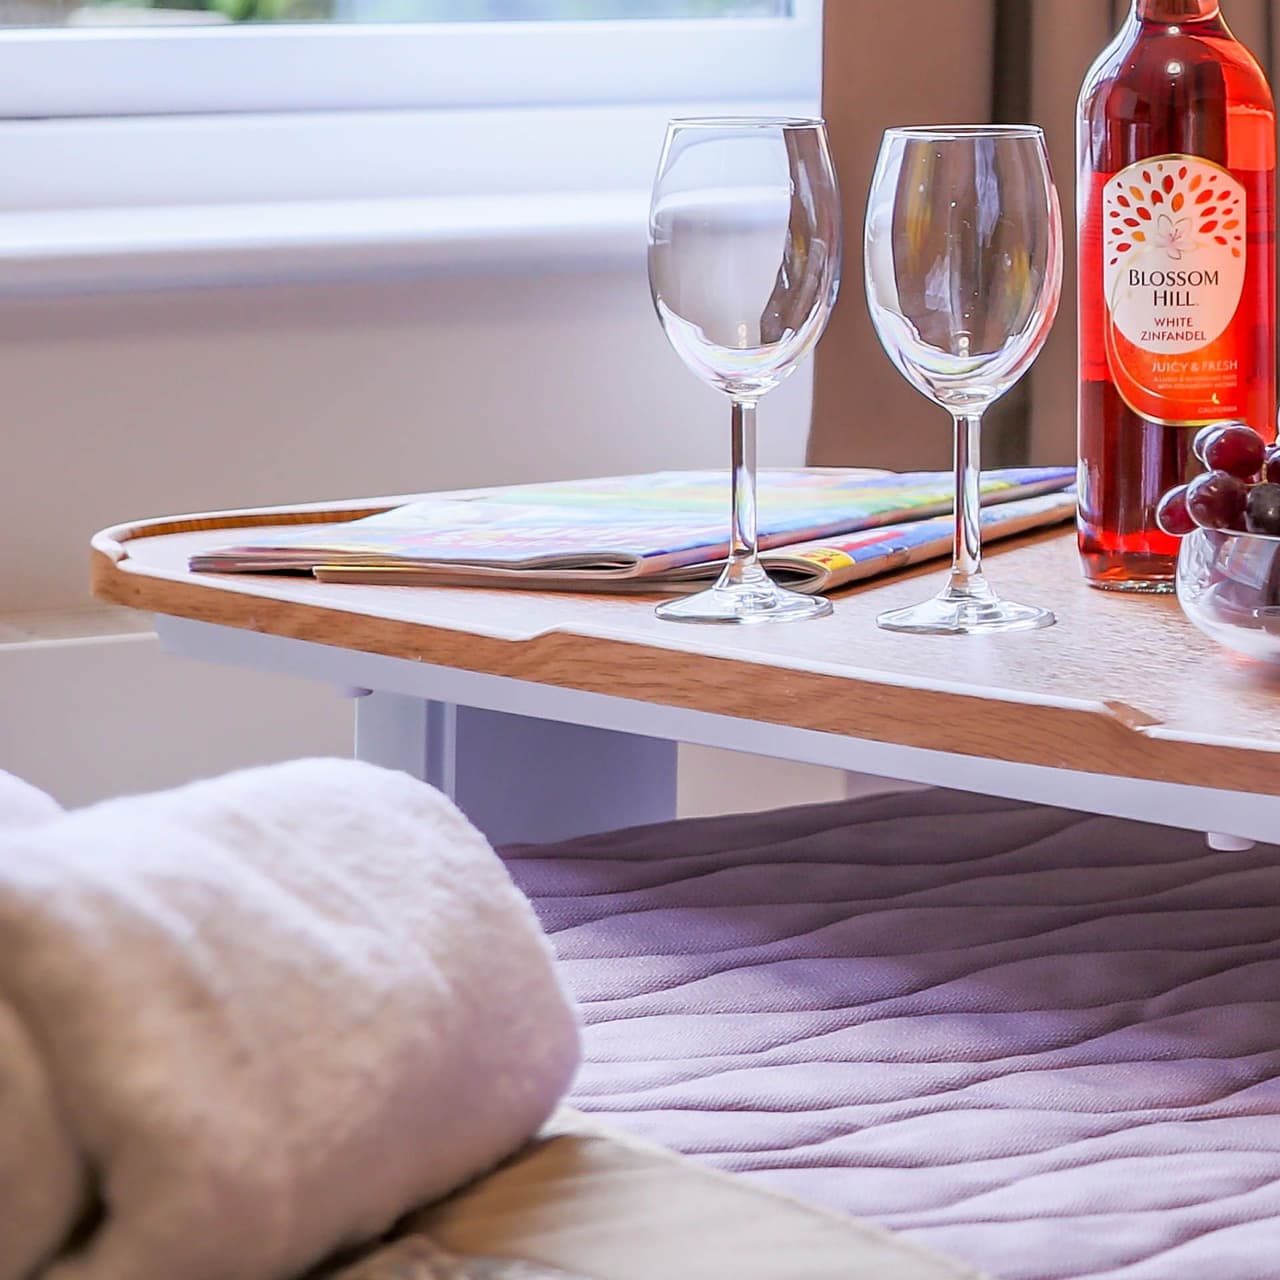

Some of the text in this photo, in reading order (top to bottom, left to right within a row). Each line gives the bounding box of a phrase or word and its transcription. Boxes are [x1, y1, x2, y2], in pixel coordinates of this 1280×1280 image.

[1129, 269, 1219, 286] BLOSSOM
[1153, 290, 1195, 306] HILL
[1154, 317, 1193, 327] WHITE
[1140, 331, 1206, 341] ZINFANDEL
[1151, 360, 1238, 373] JUICY & FRESH
